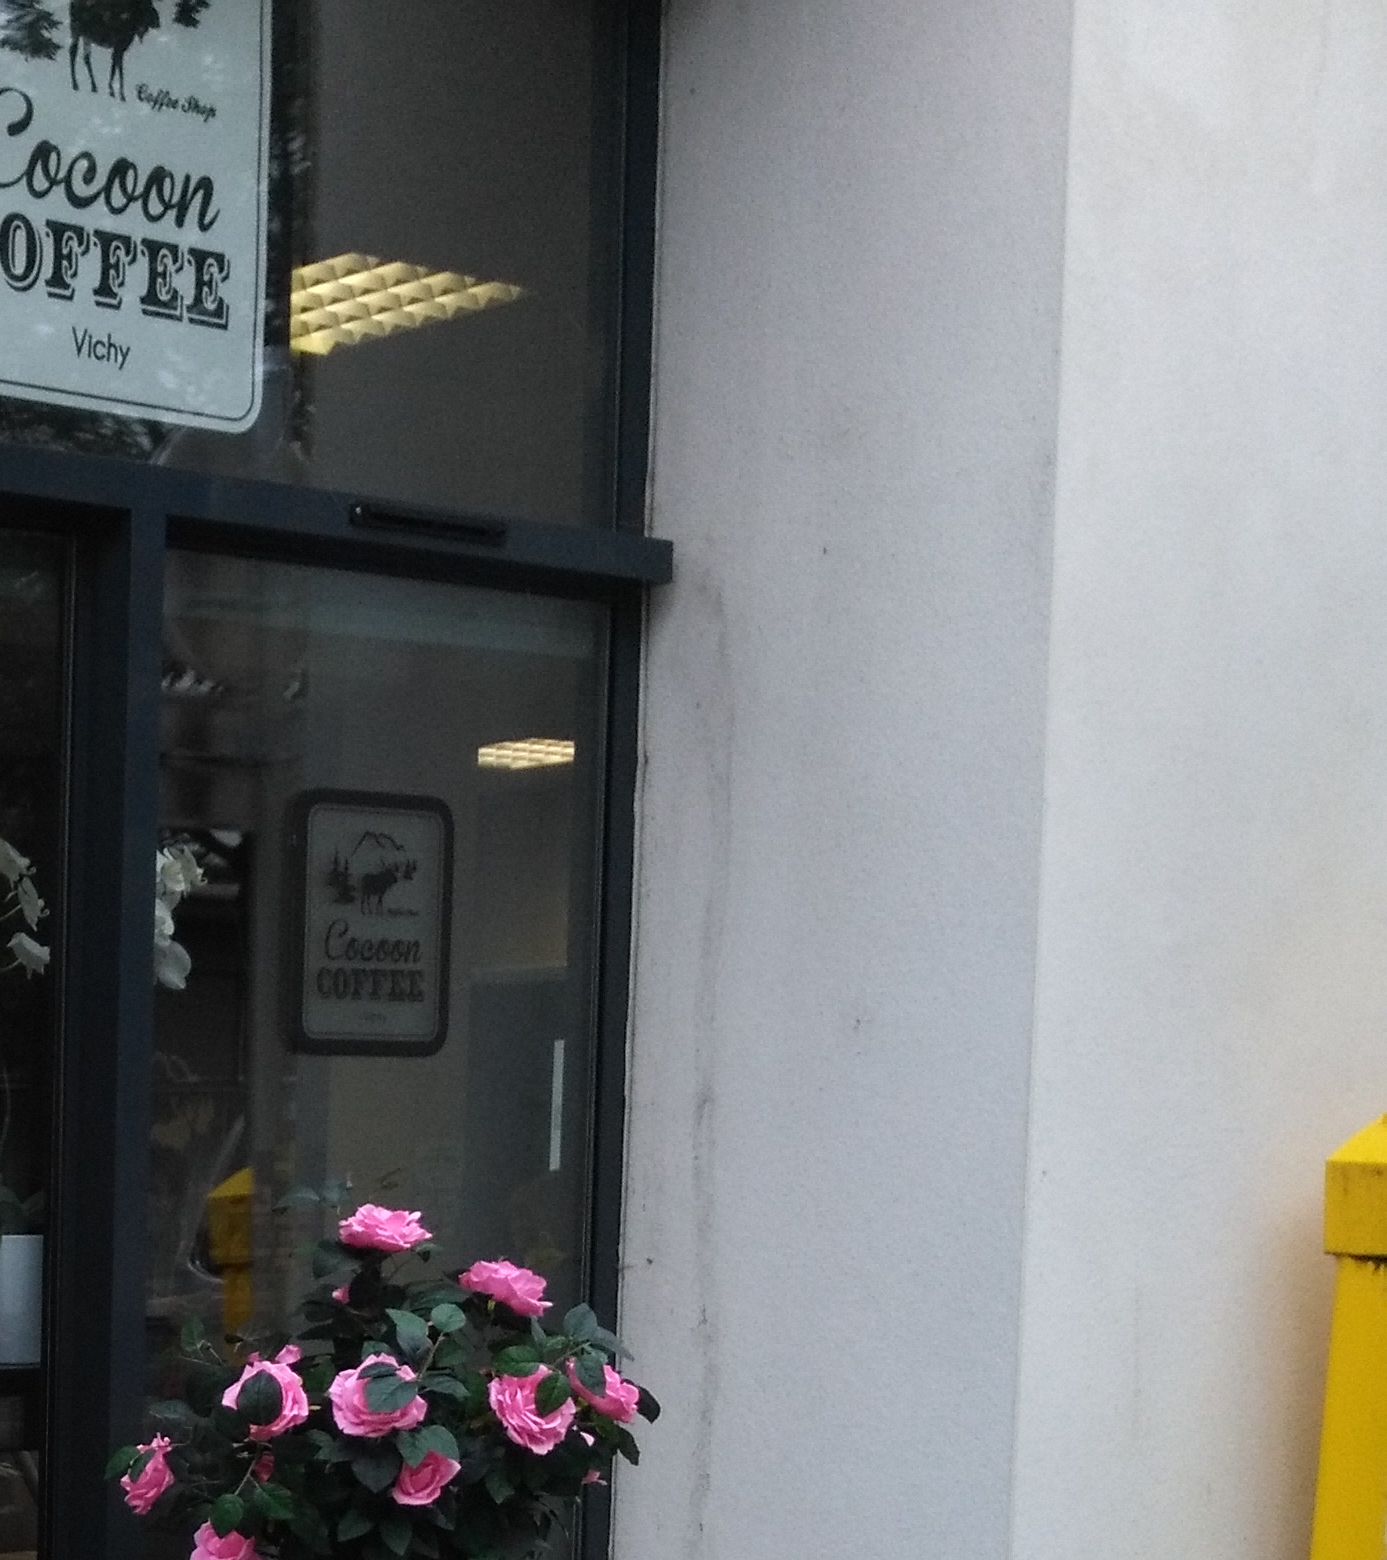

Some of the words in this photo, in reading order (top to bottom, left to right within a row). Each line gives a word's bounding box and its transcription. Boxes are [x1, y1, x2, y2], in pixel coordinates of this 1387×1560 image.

[135, 83, 179, 112] Coffee
[181, 95, 217, 122] Shop
[72, 326, 131, 370] Vichy
[324, 919, 423, 964] Cocoon
[317, 966, 425, 1003] COFFEE
